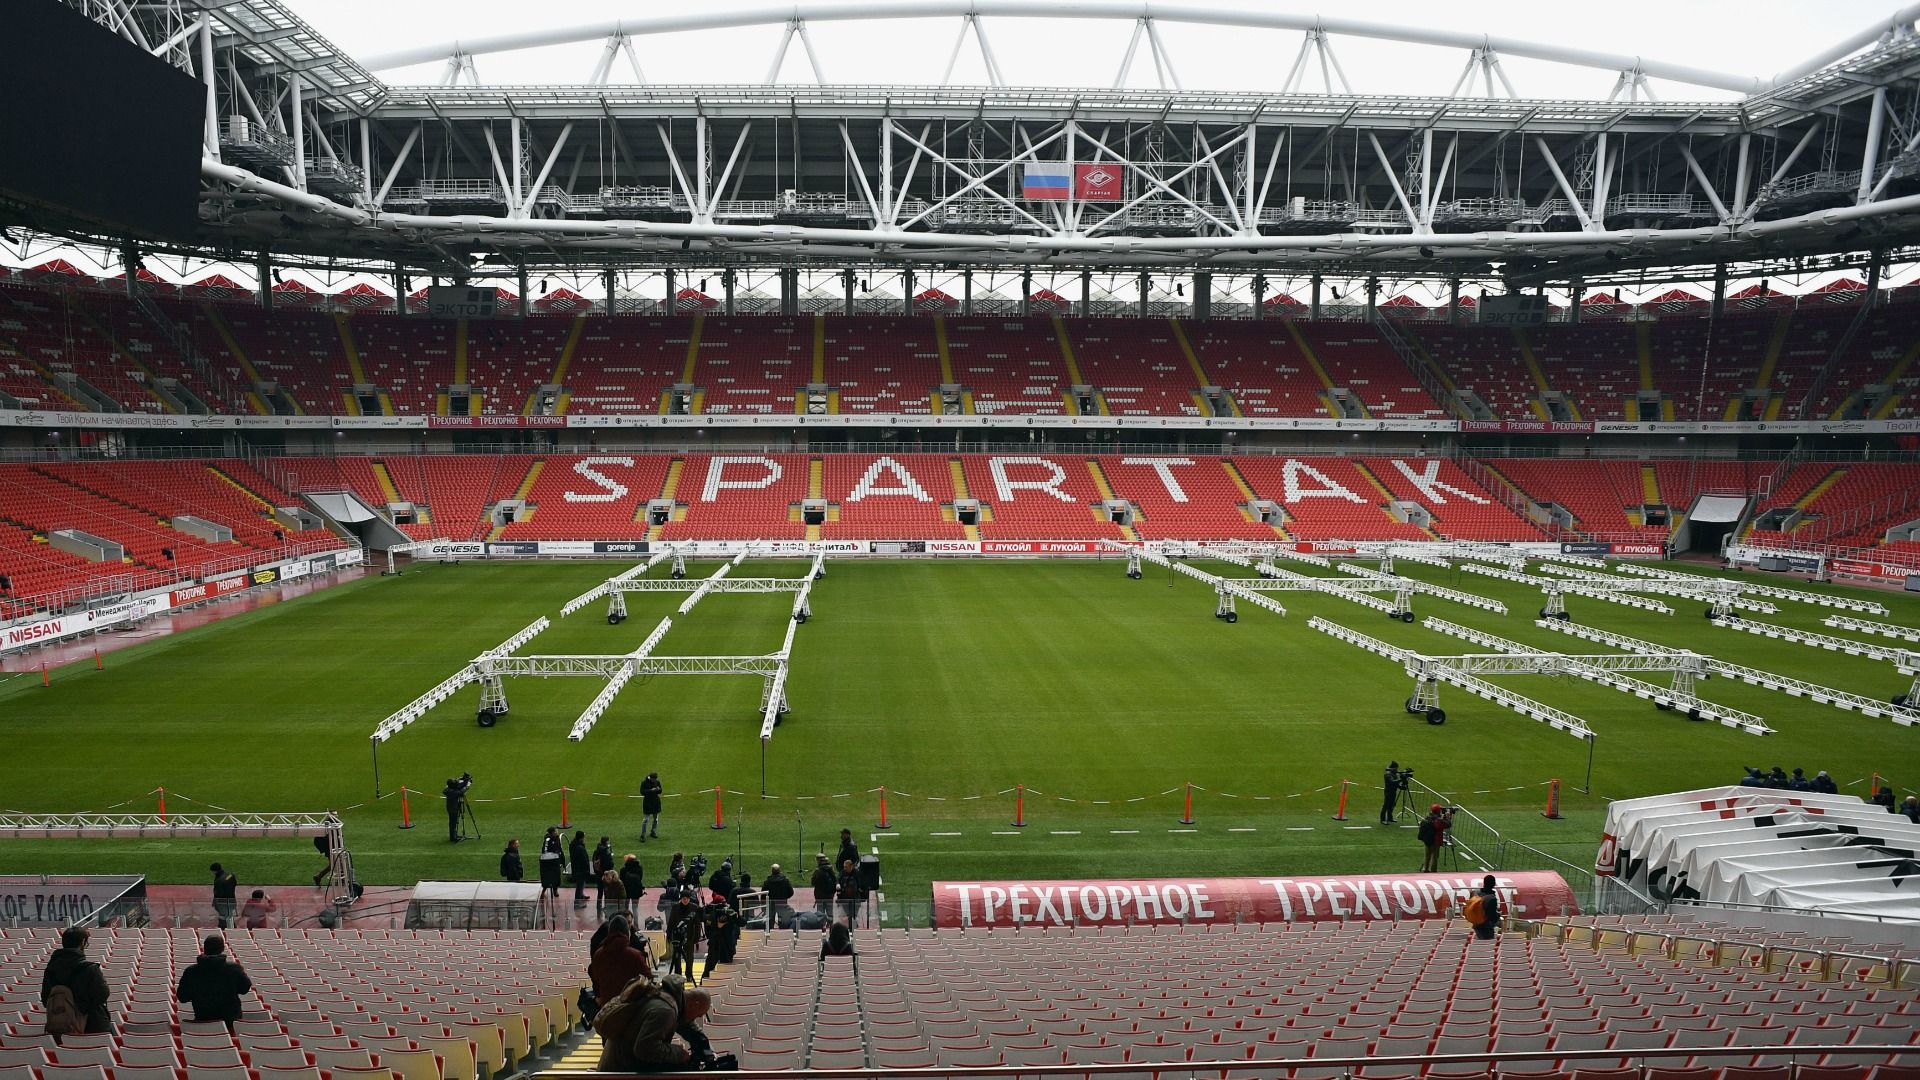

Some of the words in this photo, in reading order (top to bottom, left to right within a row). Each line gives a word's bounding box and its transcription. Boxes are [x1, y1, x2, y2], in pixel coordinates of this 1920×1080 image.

[563, 456, 1491, 503] SPARTAK
[607, 543, 636, 552] gorenje
[931, 543, 975, 551] NISSAN
[995, 542, 1031, 552] ЛУКОЙЛ
[1050, 542, 1085, 552] ЛУКОЙЛ
[1623, 544, 1659, 554] ЛУКОЙЛ
[9, 621, 62, 643] NISSAN
[34, 894, 94, 921] РАДИО
